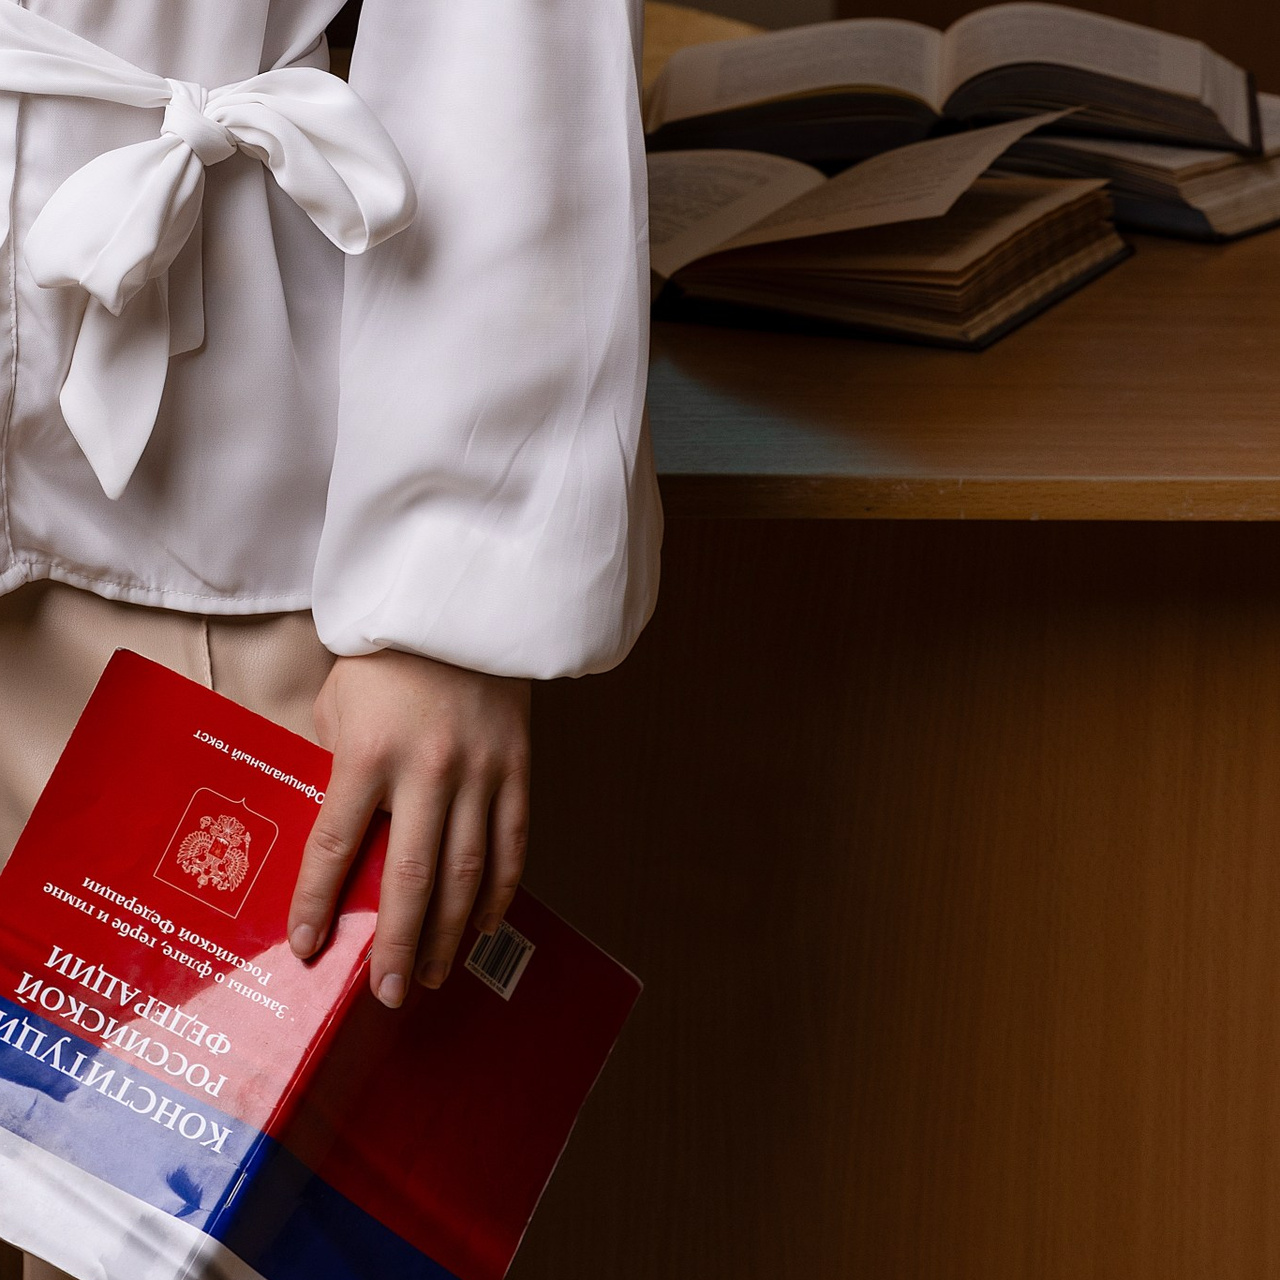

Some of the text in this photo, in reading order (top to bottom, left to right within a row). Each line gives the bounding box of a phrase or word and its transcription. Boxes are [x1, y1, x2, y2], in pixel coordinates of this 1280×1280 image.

[193, 730, 325, 805] Официальный текст
[43, 882, 289, 1018] Законы о флаге, гербе и гимне
[82, 877, 274, 987] Российской Федерации
[14, 972, 228, 1098] РОССИЙСКОЙ
[44, 944, 232, 1056] ФЕДЕРАЦИИ
